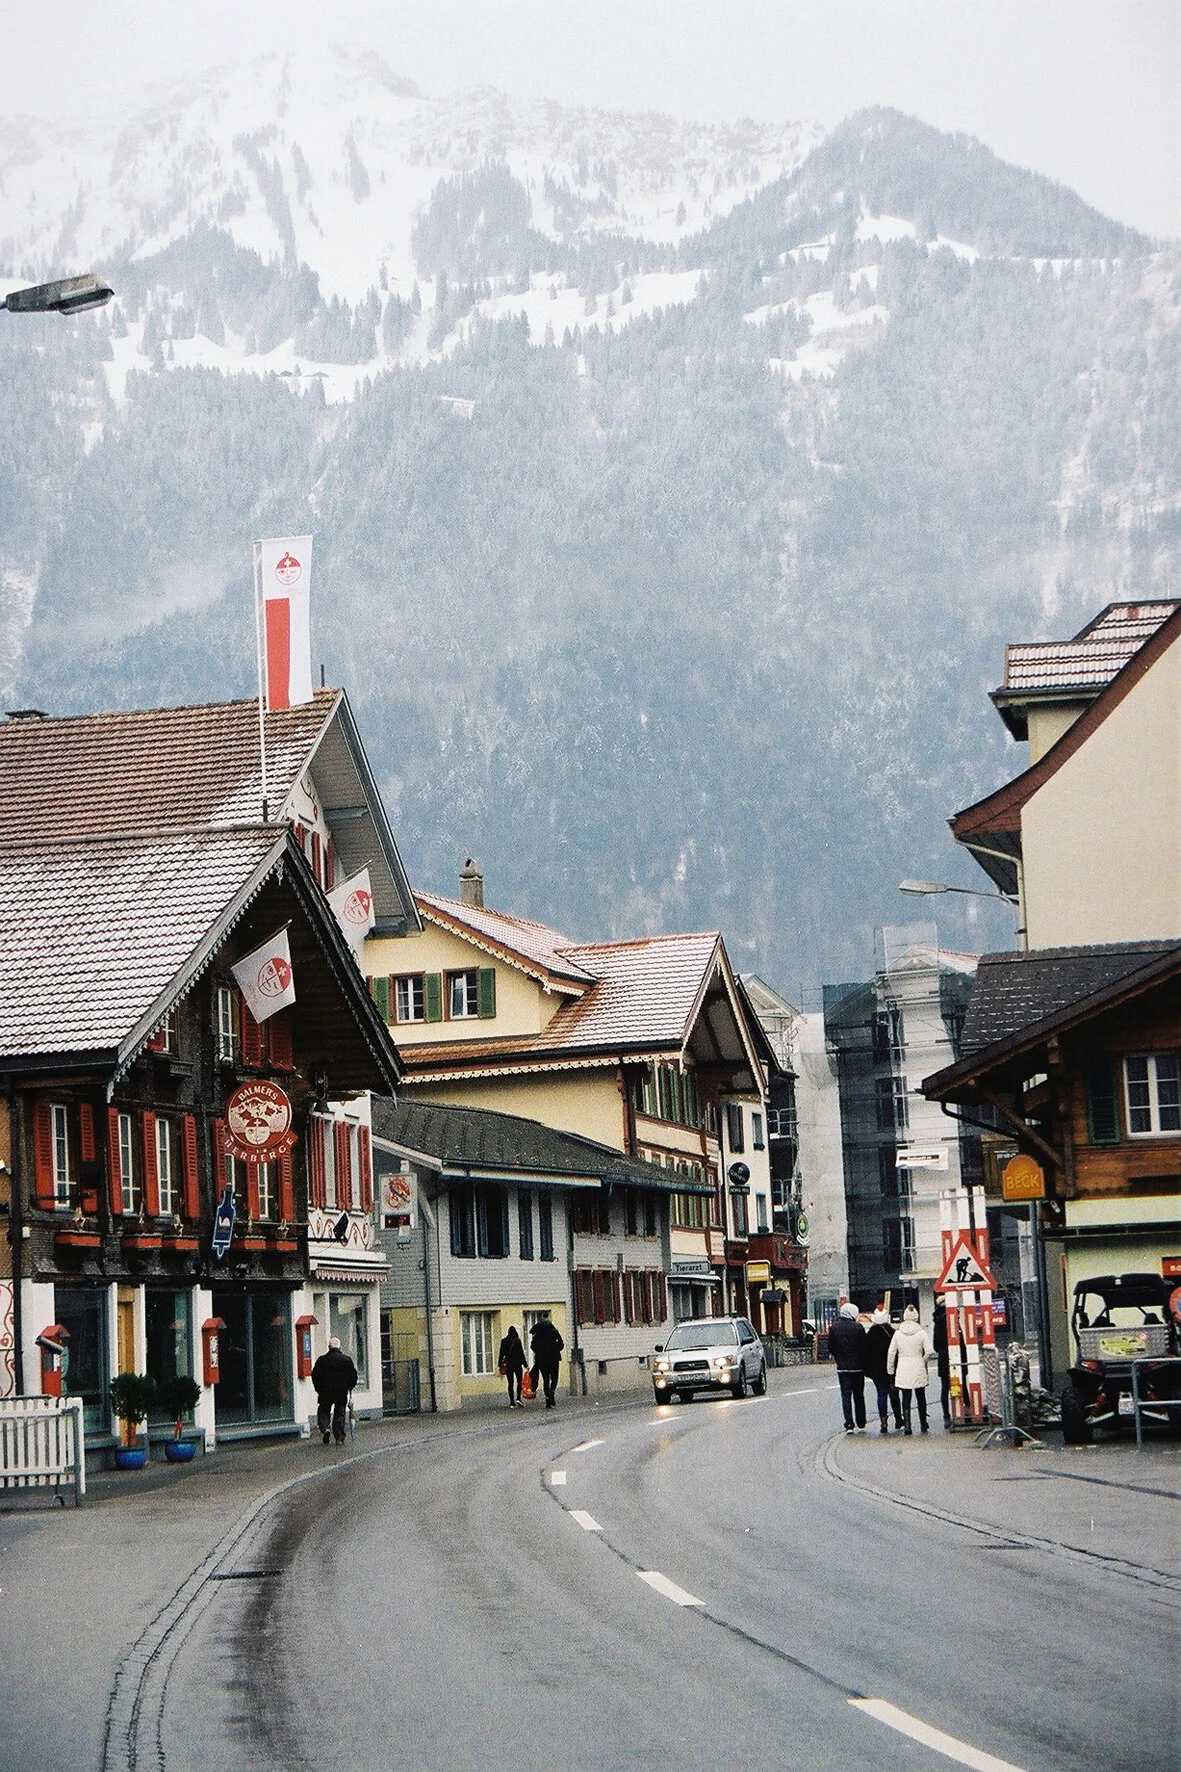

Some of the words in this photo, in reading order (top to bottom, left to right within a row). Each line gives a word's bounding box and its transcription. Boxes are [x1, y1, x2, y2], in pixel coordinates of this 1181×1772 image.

[237, 1086, 278, 1101] BALMERS
[1006, 1174, 1040, 1189] BECK
[675, 1264, 702, 1272] Tierarzt
